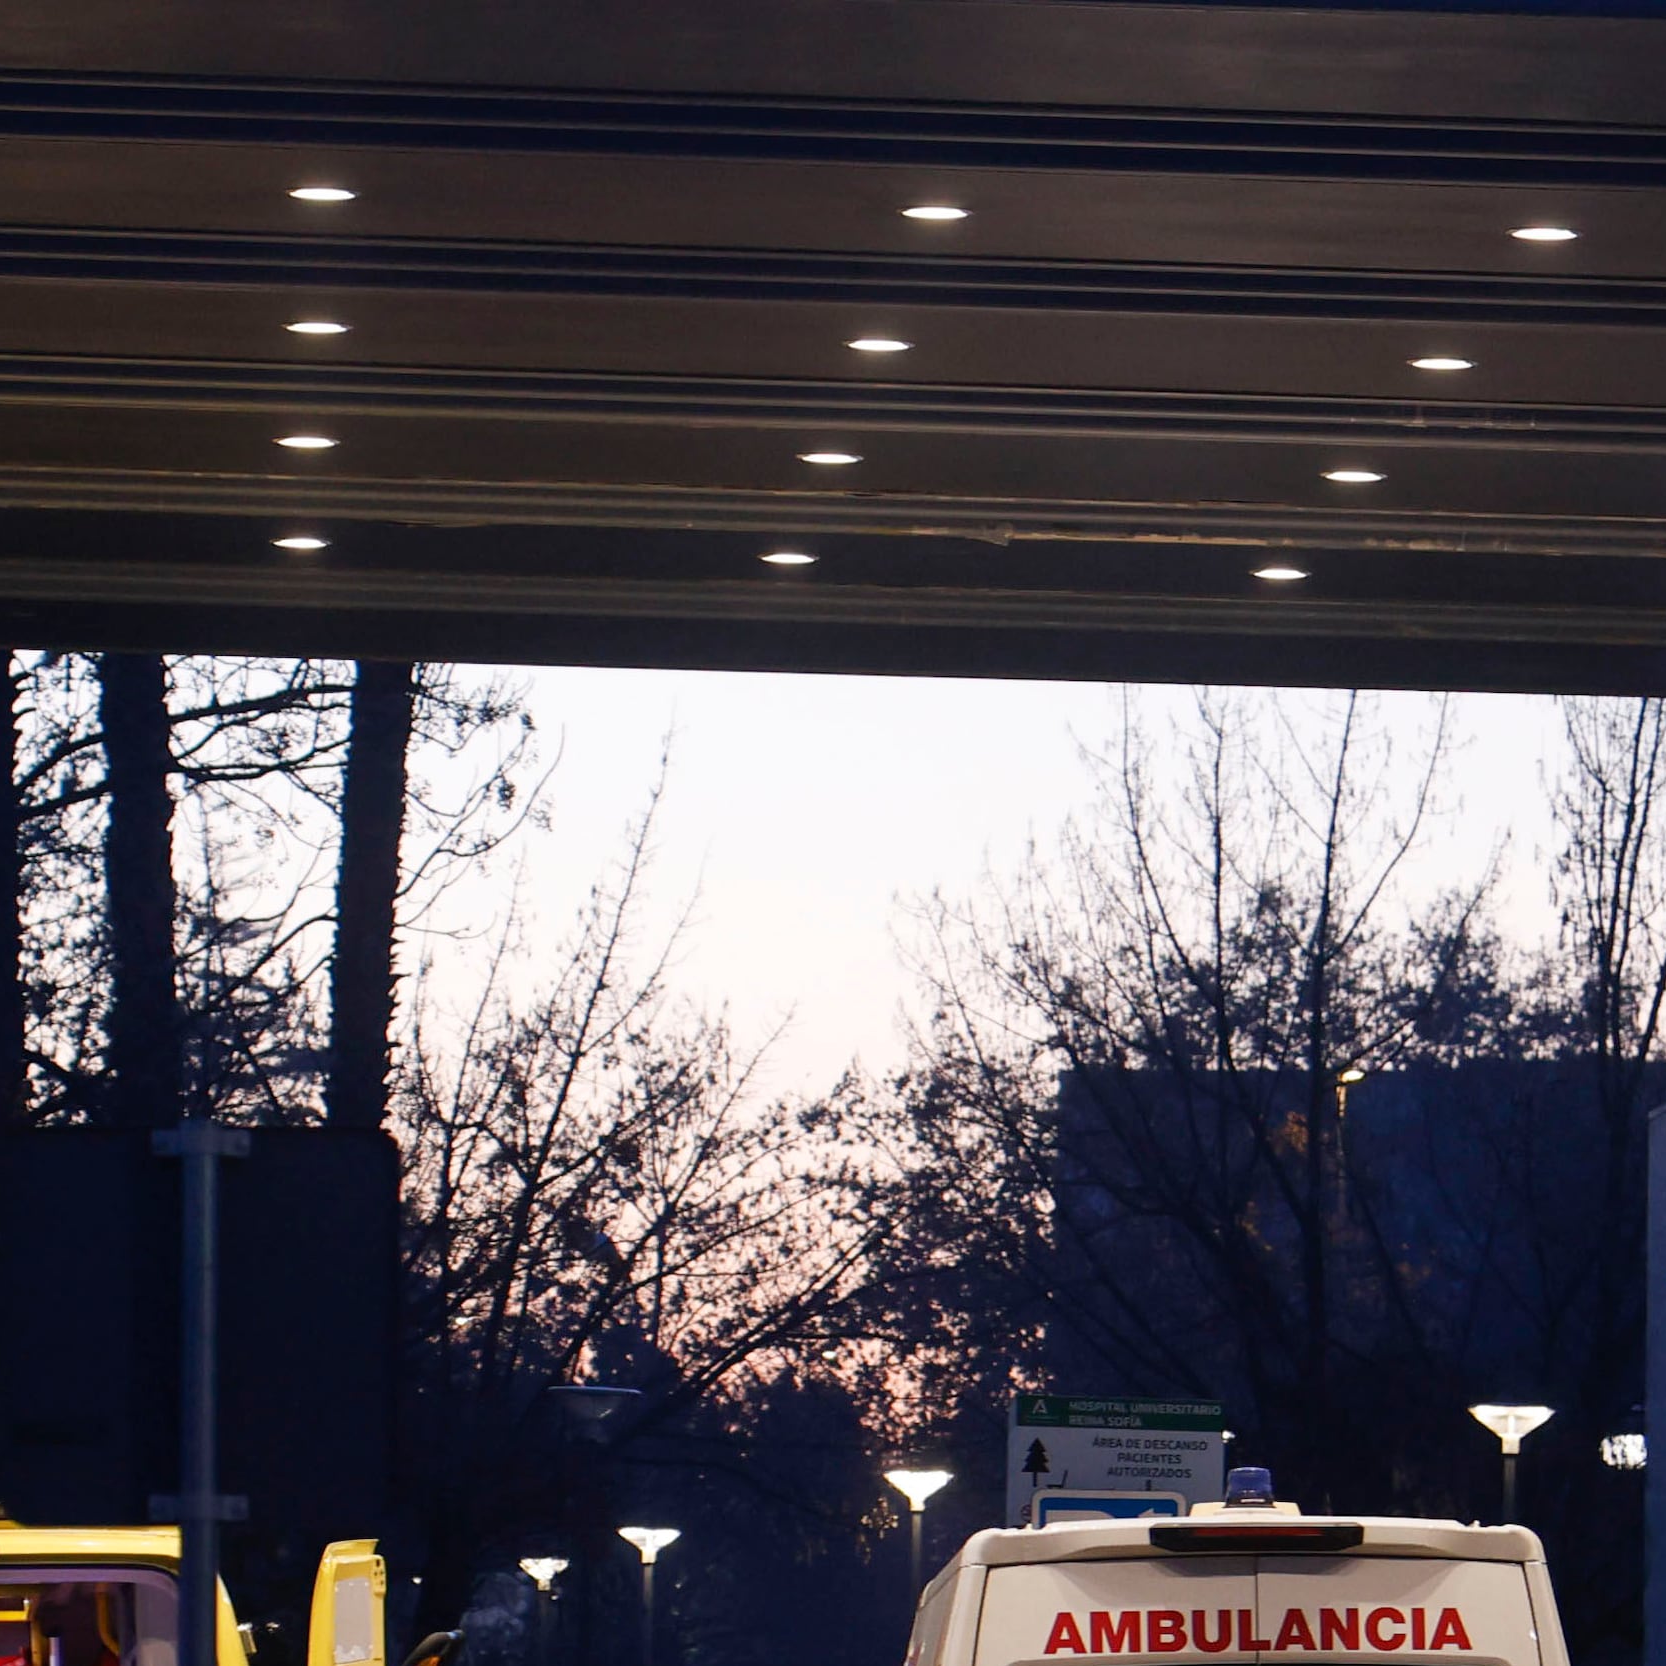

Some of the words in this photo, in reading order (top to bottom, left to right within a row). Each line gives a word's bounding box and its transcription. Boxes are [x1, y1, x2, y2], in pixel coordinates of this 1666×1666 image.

[1132, 1402, 1221, 1416] UNIVERSITARIO
[1092, 1436, 1122, 1449] ÁREA
[1126, 1439, 1142, 1449] DE
[1145, 1439, 1208, 1451] DESCANSO
[1117, 1453, 1182, 1465] PACIENTES
[1107, 1467, 1192, 1479] AUTORIZADOS
[1044, 1607, 1473, 1655] AMBULANCIA
